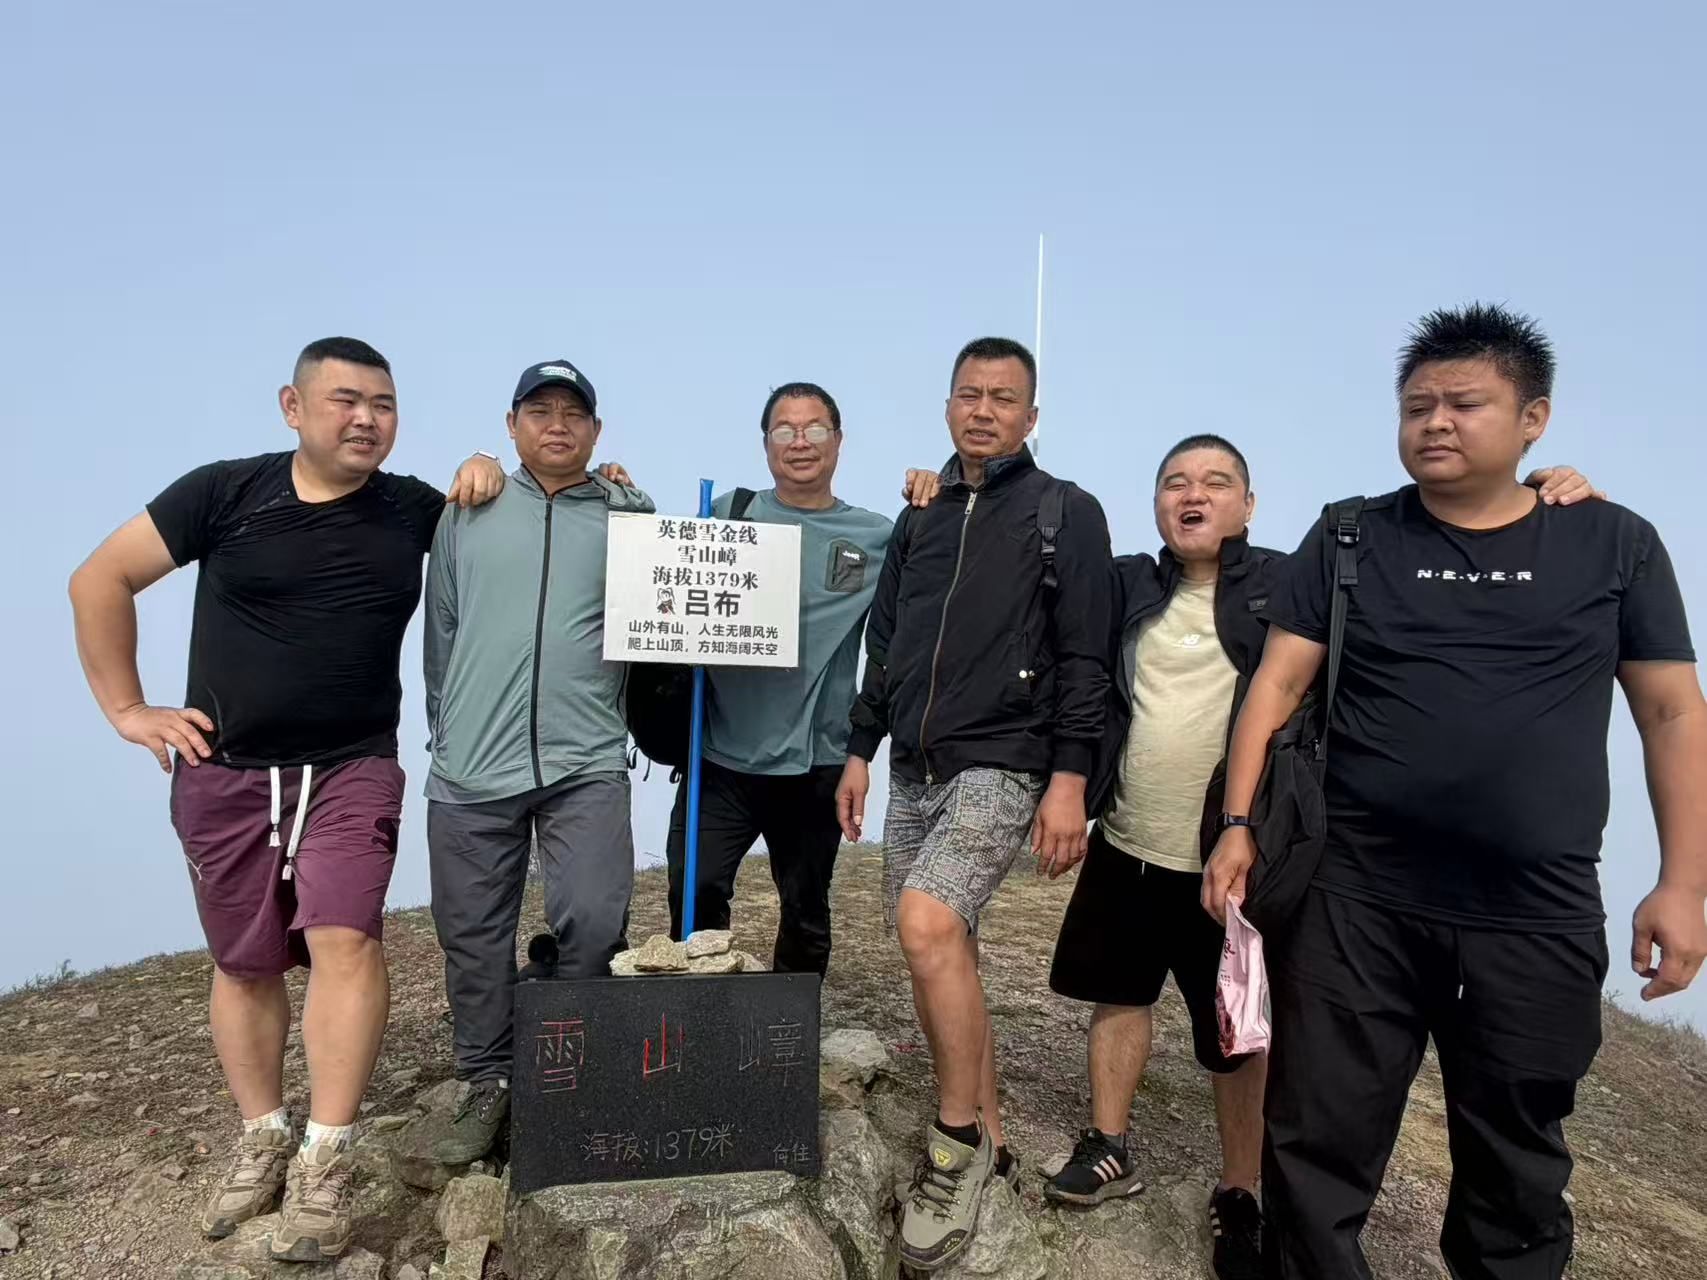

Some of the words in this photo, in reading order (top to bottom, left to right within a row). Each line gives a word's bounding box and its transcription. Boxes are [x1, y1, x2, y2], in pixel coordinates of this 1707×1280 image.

[657, 520, 758, 545] 英德雪金线
[678, 545, 737, 566] 雪山嶂
[652, 566, 759, 590] 海拔1379米
[685, 589, 741, 617] 吕布
